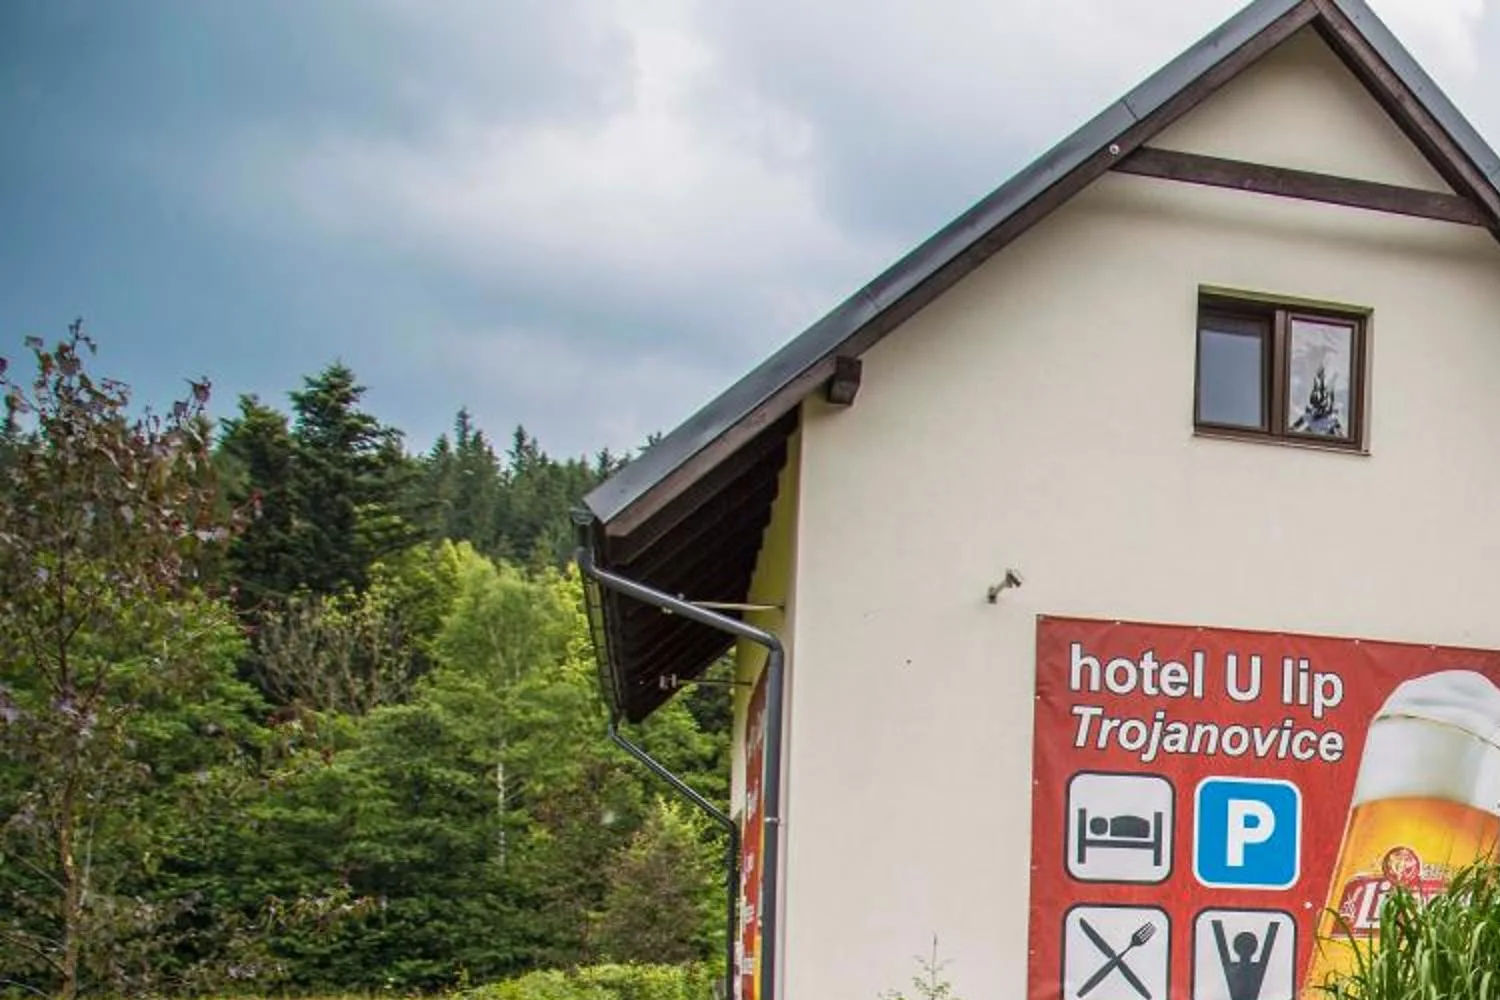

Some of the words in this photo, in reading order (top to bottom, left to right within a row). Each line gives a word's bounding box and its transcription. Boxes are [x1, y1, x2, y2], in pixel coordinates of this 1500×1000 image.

[1070, 642, 1206, 699] hotel
[1226, 654, 1262, 701] U
[1282, 658, 1345, 718] lip
[1071, 706, 1345, 763] Trojanovice
[1227, 799, 1275, 866] P
